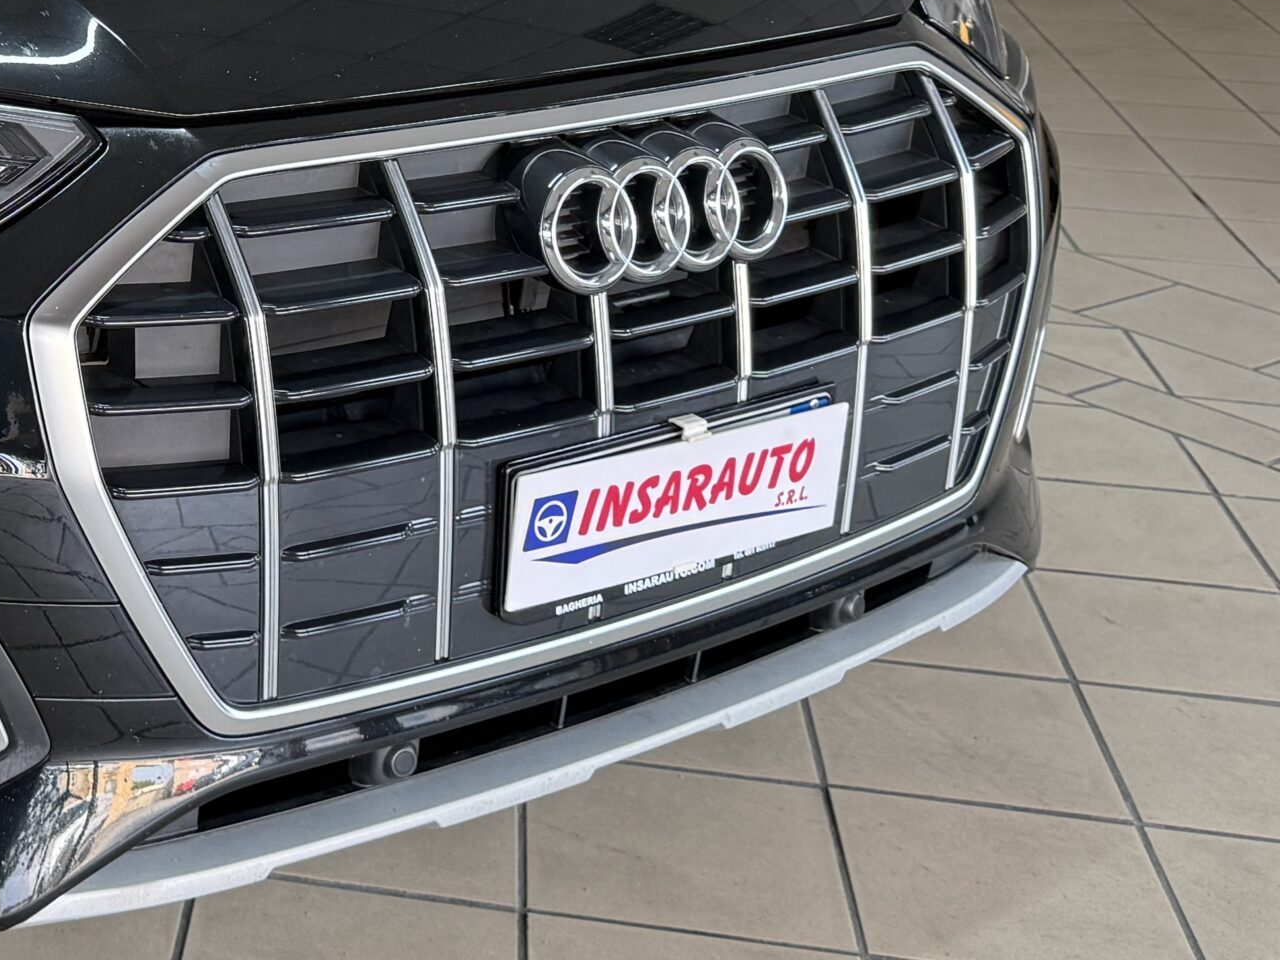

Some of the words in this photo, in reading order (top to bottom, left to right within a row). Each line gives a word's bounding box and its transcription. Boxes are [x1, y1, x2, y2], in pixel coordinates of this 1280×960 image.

[578, 437, 816, 536] INSARAUTO
[774, 485, 809, 508] S.R.L.
[624, 558, 716, 596] INSARAUTO.COM
[555, 593, 604, 616] BAGHERIA
